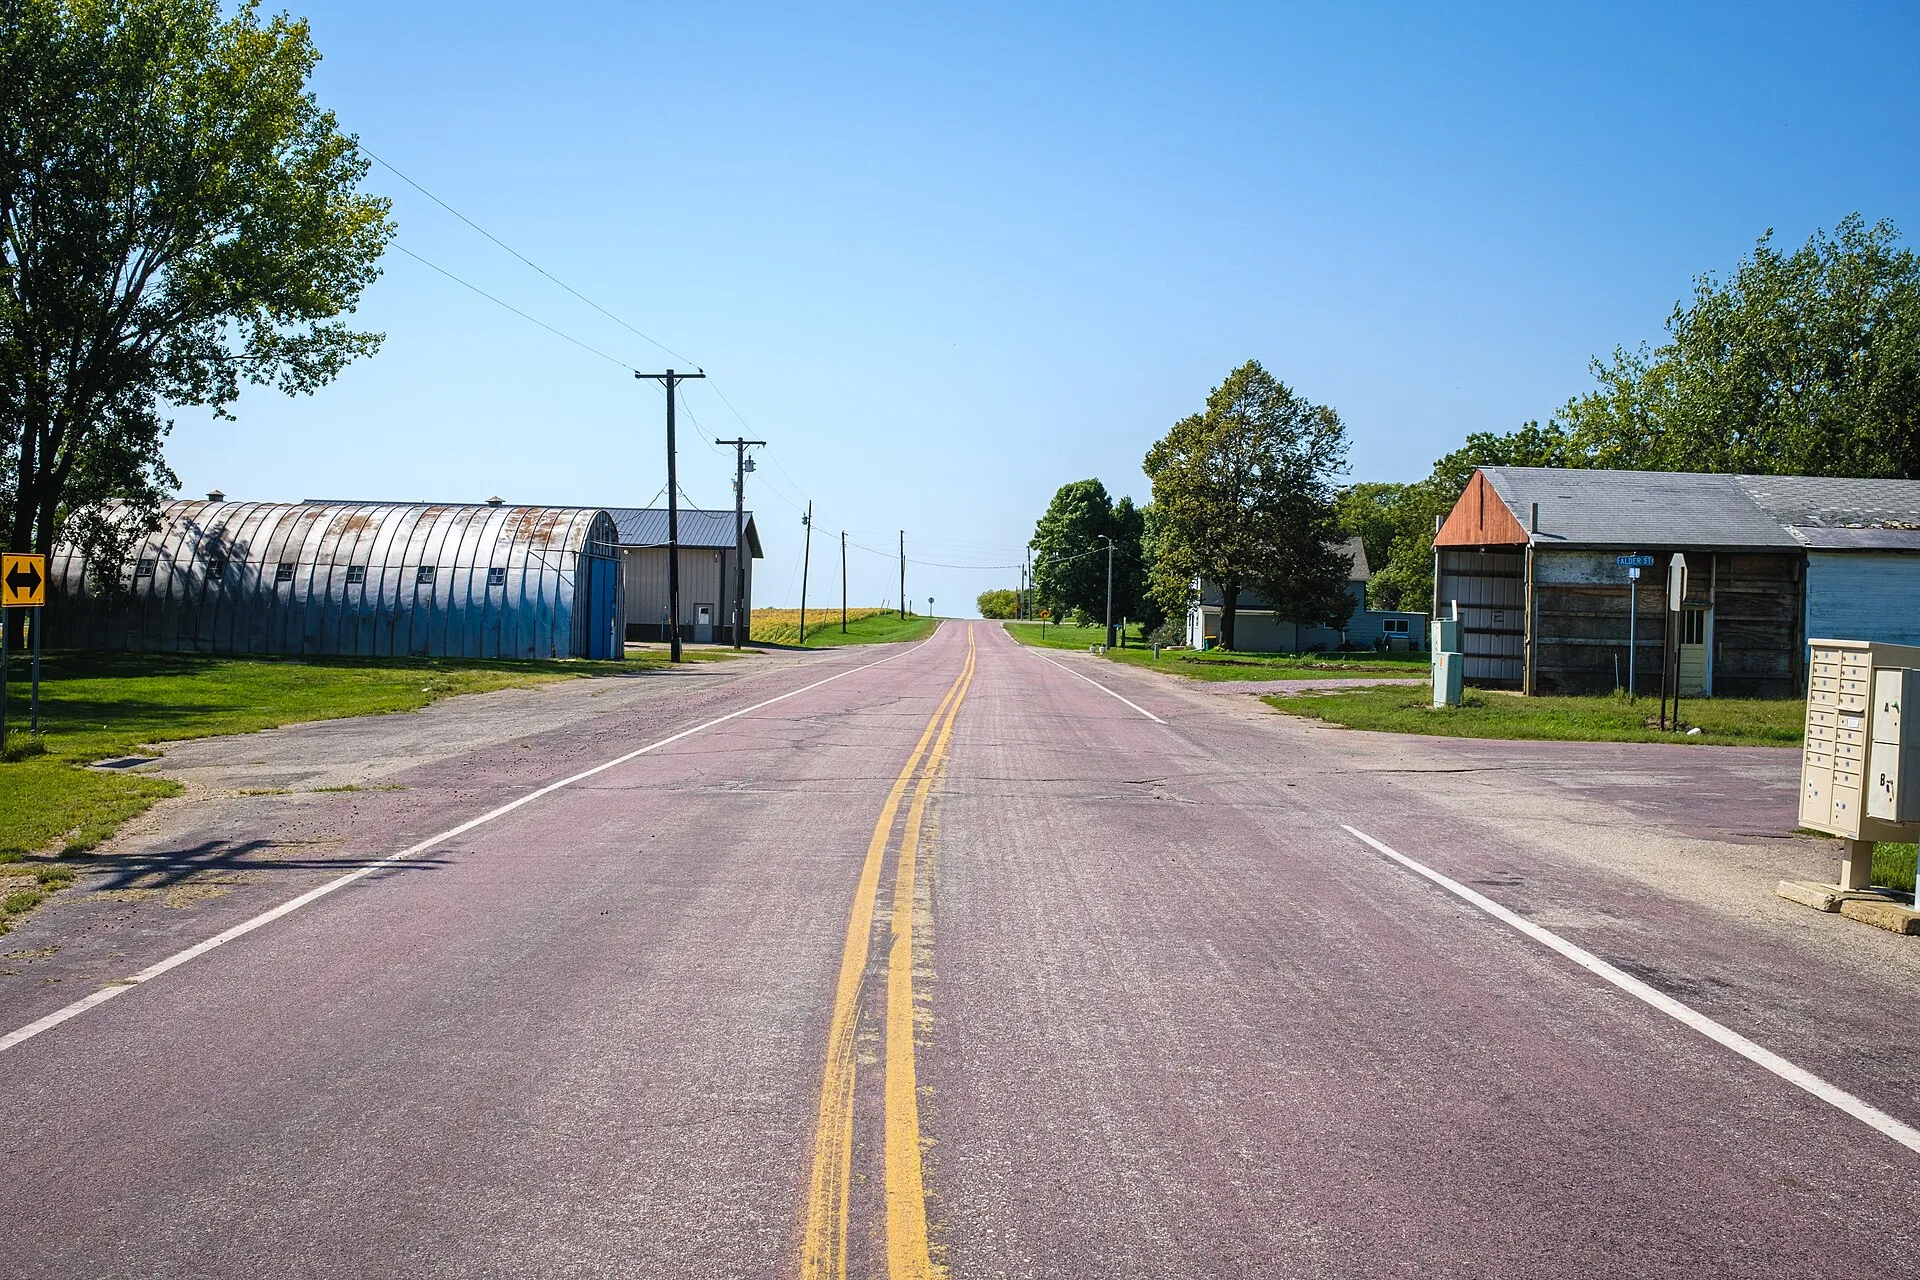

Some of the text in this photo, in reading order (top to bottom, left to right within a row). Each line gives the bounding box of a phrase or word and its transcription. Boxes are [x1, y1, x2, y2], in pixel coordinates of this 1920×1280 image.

[1620, 557, 1651, 565] ALDER ST
[1884, 702, 1889, 713] A
[1880, 773, 1886, 786] B
